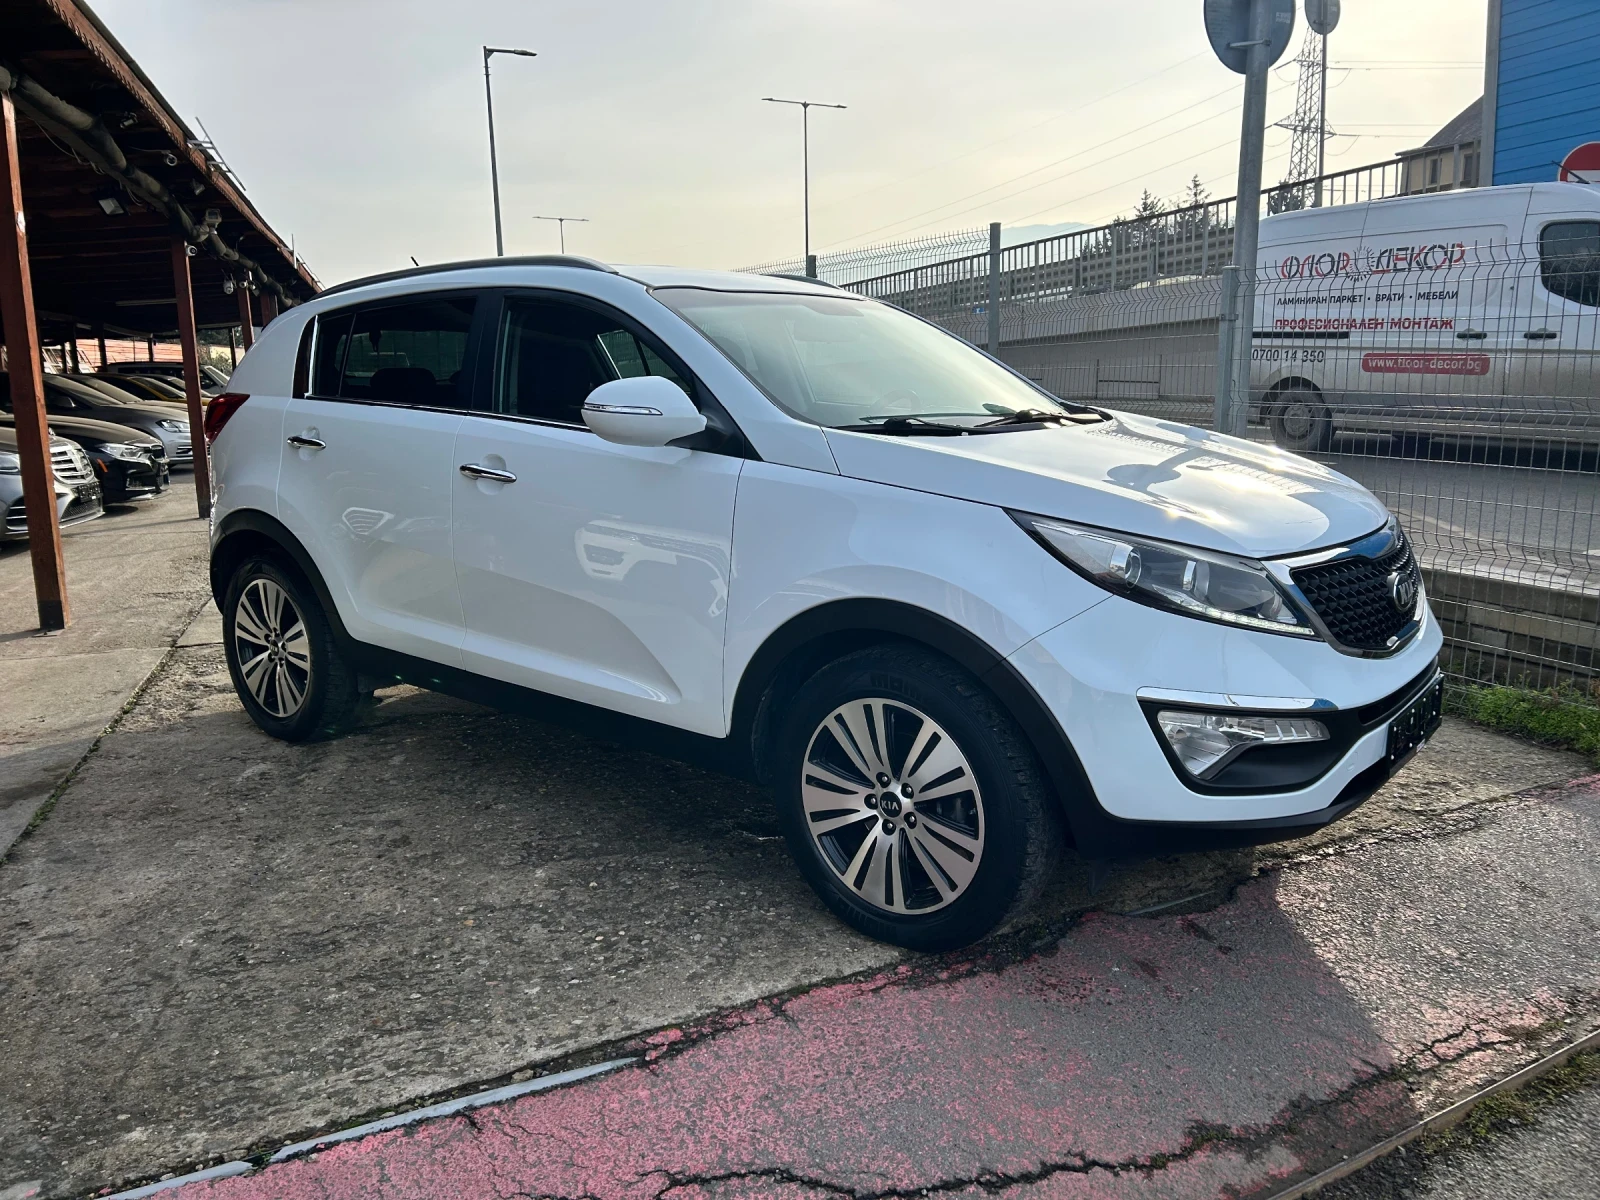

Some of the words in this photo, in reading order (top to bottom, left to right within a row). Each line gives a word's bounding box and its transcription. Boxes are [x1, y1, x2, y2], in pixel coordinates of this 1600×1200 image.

[1281, 252, 1350, 279] ФЛОР
[1372, 243, 1465, 274] ДЕКОР
[1277, 295, 1327, 306] ЛАМИНИРАН
[1329, 294, 1363, 304] ПАРКЕТ
[1375, 293, 1404, 302] ВРАТИ
[1417, 290, 1458, 301] МЕБЕЛИ
[1274, 318, 1384, 331] ПРОФЕСИОНАЛЕН
[1390, 318, 1454, 330] МОНТАЖ
[1252, 349, 1280, 361] 0700
[1284, 350, 1298, 362] 14
[1302, 350, 1325, 363] 350
[1368, 357, 1482, 372] www.floor-decor.bg
[880, 799, 899, 811] KIA
